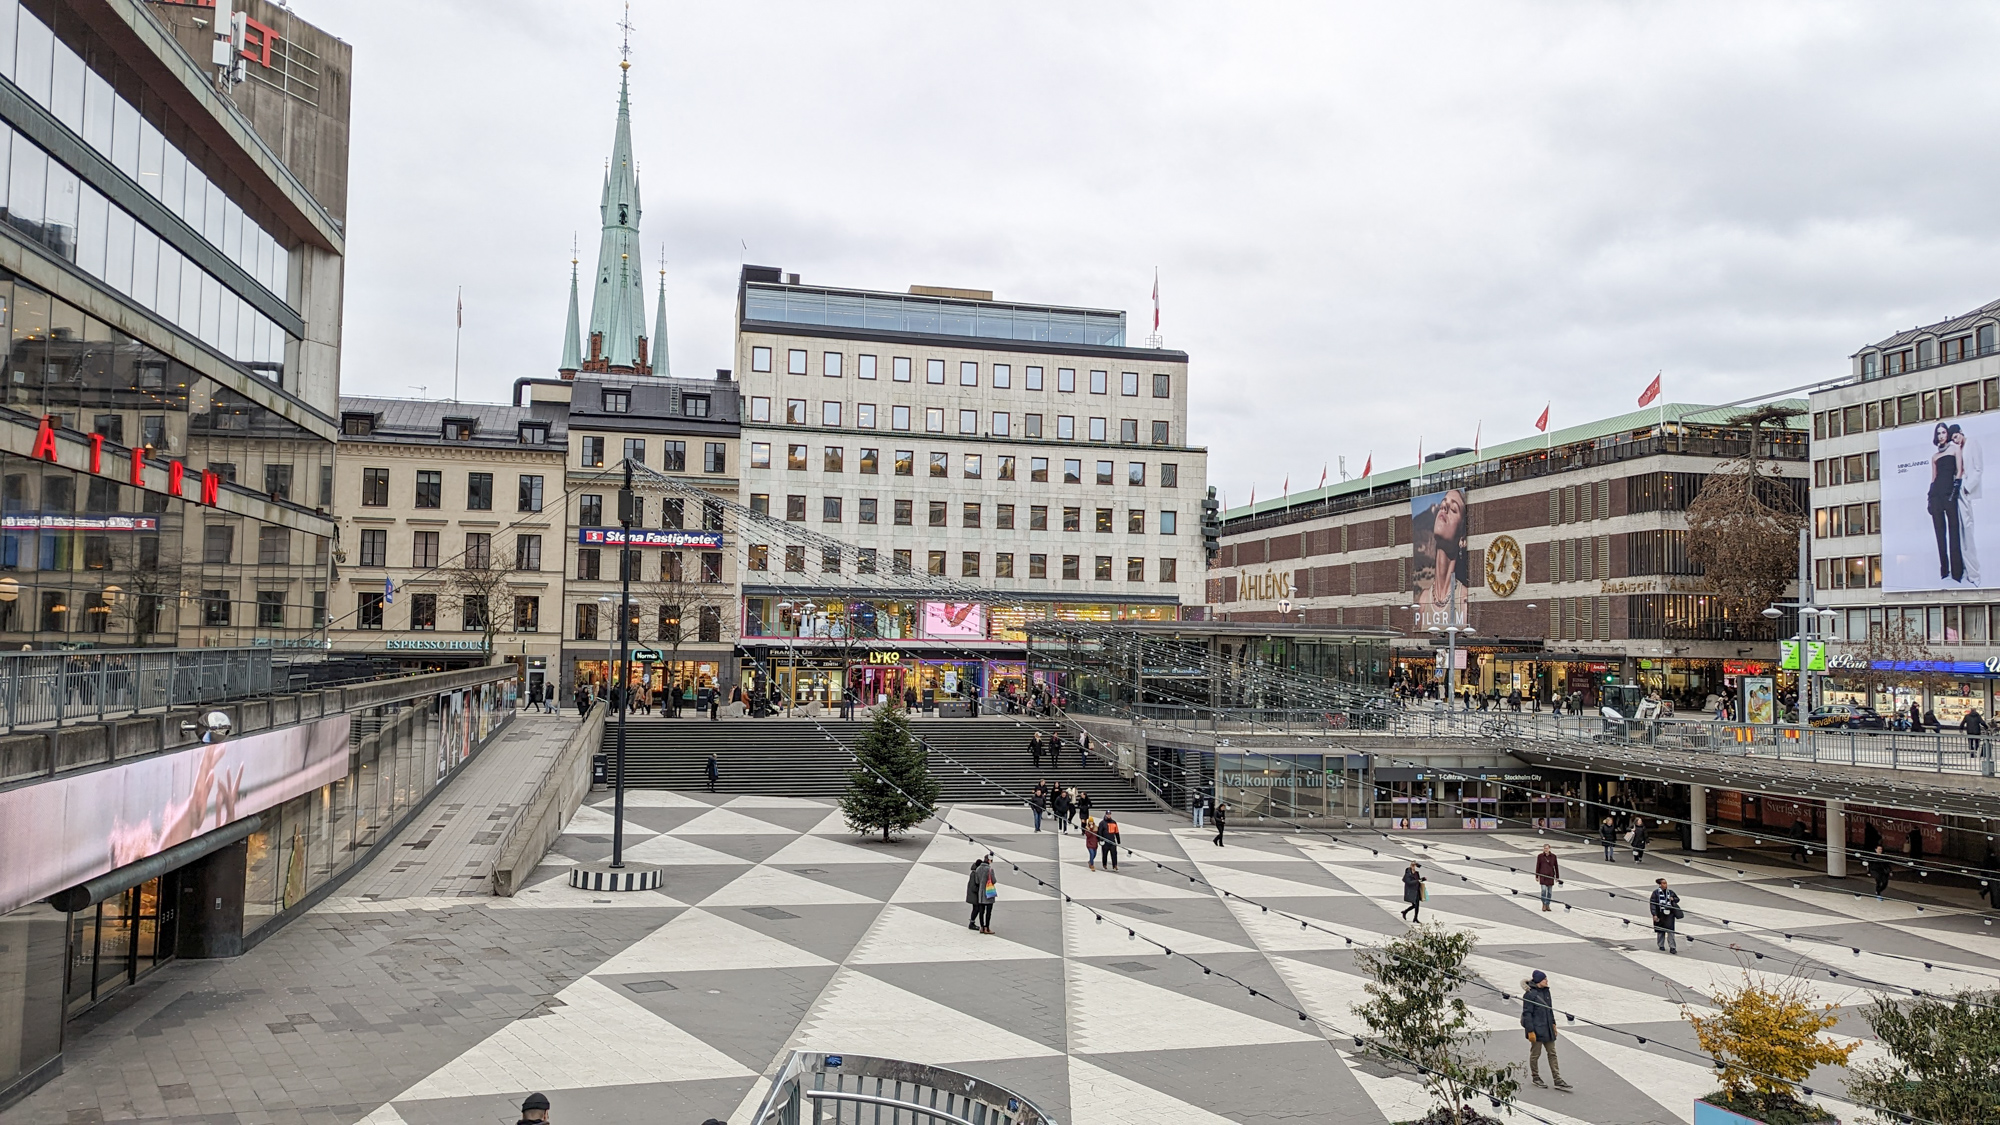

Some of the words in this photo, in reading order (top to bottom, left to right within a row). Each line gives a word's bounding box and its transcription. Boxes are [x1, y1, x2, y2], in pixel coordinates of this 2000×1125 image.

[605, 530, 645, 543] Stena
[646, 532, 719, 546] Fastigheter
[1238, 568, 1290, 601] ÅHLÉNS
[1415, 611, 1464, 626] PILGRM
[386, 640, 447, 650] ESPRESSO
[450, 640, 490, 651] HOUSE
[869, 651, 900, 664] LYKO
[1225, 773, 1303, 788] Välkommen
[1306, 774, 1323, 788] till
[1326, 774, 1344, 788] SL
[1531, 774, 1542, 782] City
[1766, 800, 1802, 817] Sveriges
